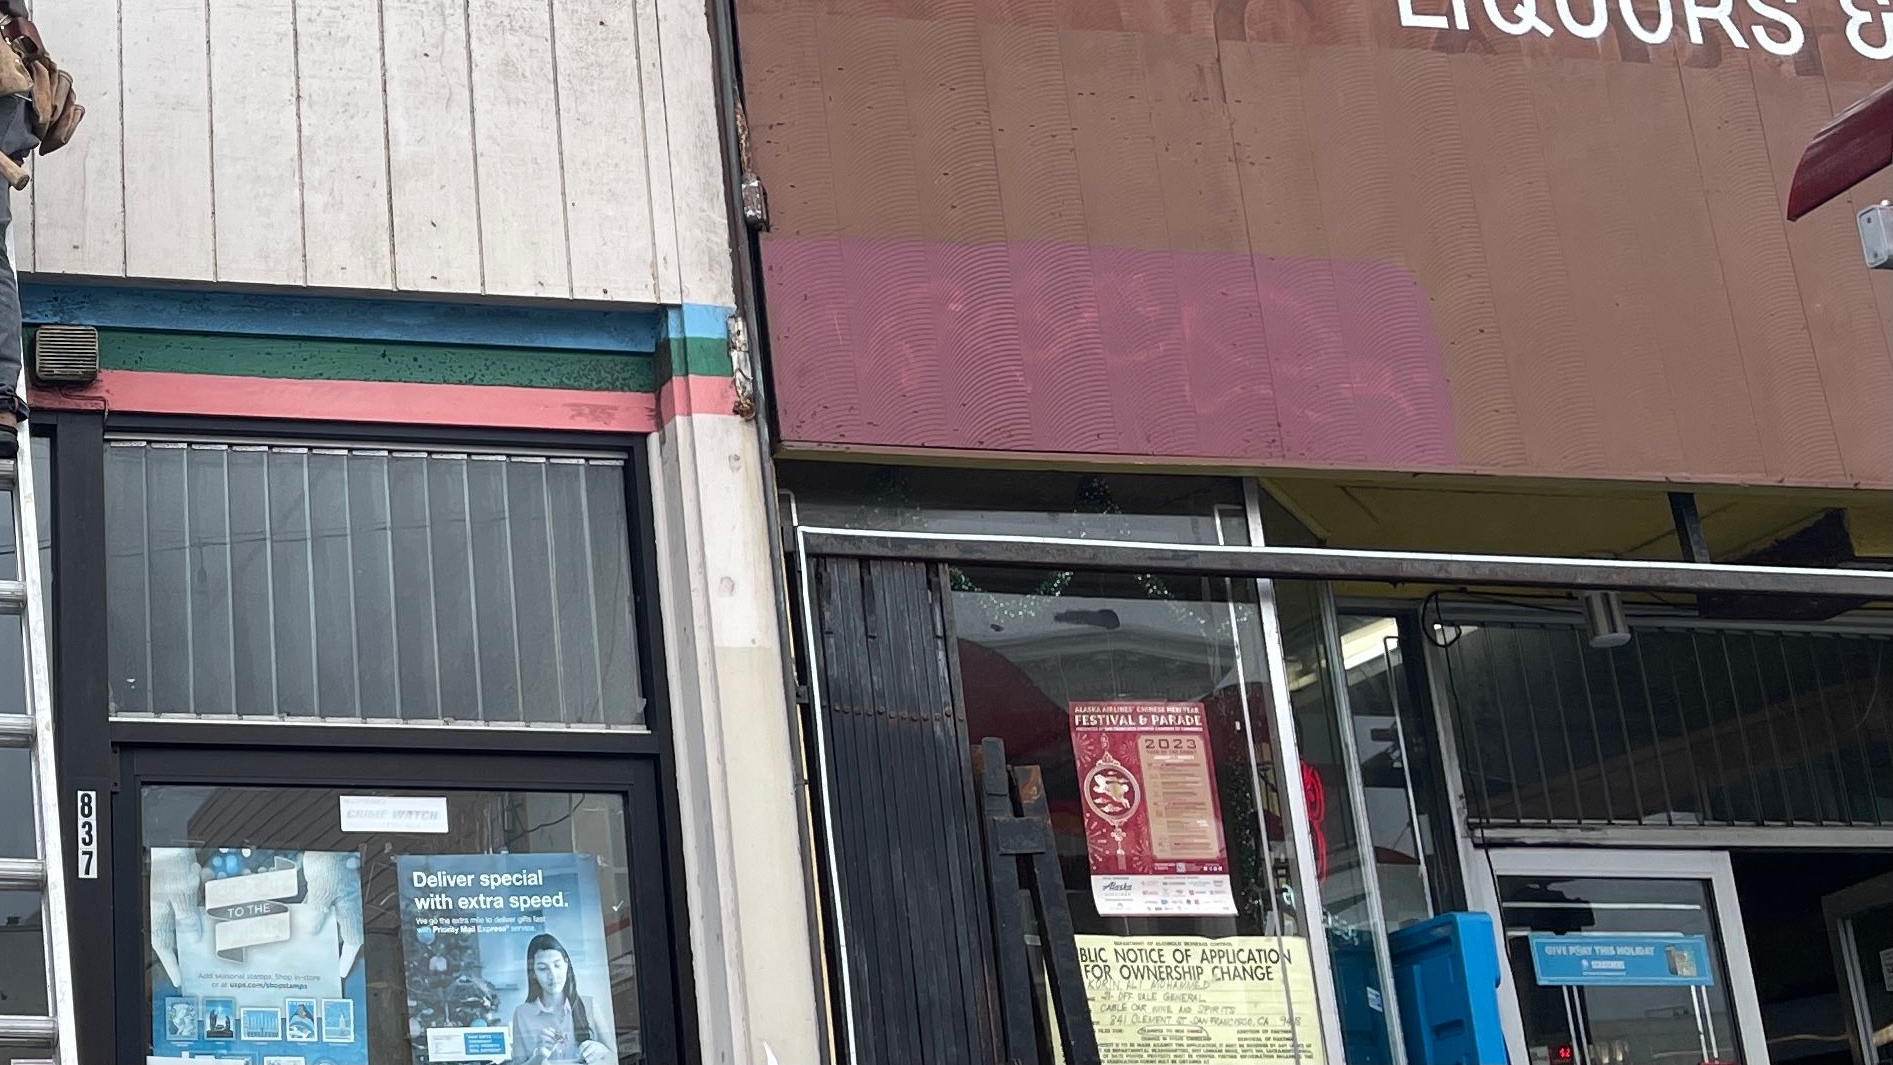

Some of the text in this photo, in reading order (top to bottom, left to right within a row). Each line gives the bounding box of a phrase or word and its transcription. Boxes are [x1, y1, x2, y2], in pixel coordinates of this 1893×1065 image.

[1075, 714, 1203, 726] FESTIVAL & PARADE
[1144, 738, 1197, 749] 2023
[412, 869, 543, 889] Deliver special
[1102, 881, 1132, 891] Alaska
[414, 891, 569, 911] with extra speed.
[227, 903, 271, 918] TO THE
[416, 917, 428, 925] We
[432, 926, 459, 934] Priority
[1080, 947, 1292, 965] BLIC NOTICE OF APPLICATION
[1084, 964, 1274, 981] FOR OWNERSHIP CHANGE
[1163, 992, 1206, 1003] GENERAL
[1100, 1003, 1127, 1013] CABLE
[1197, 1005, 1236, 1015] SPIRITS
[1131, 1014, 1173, 1026] CLEMENT
[1257, 1016, 1270, 1026] CA
